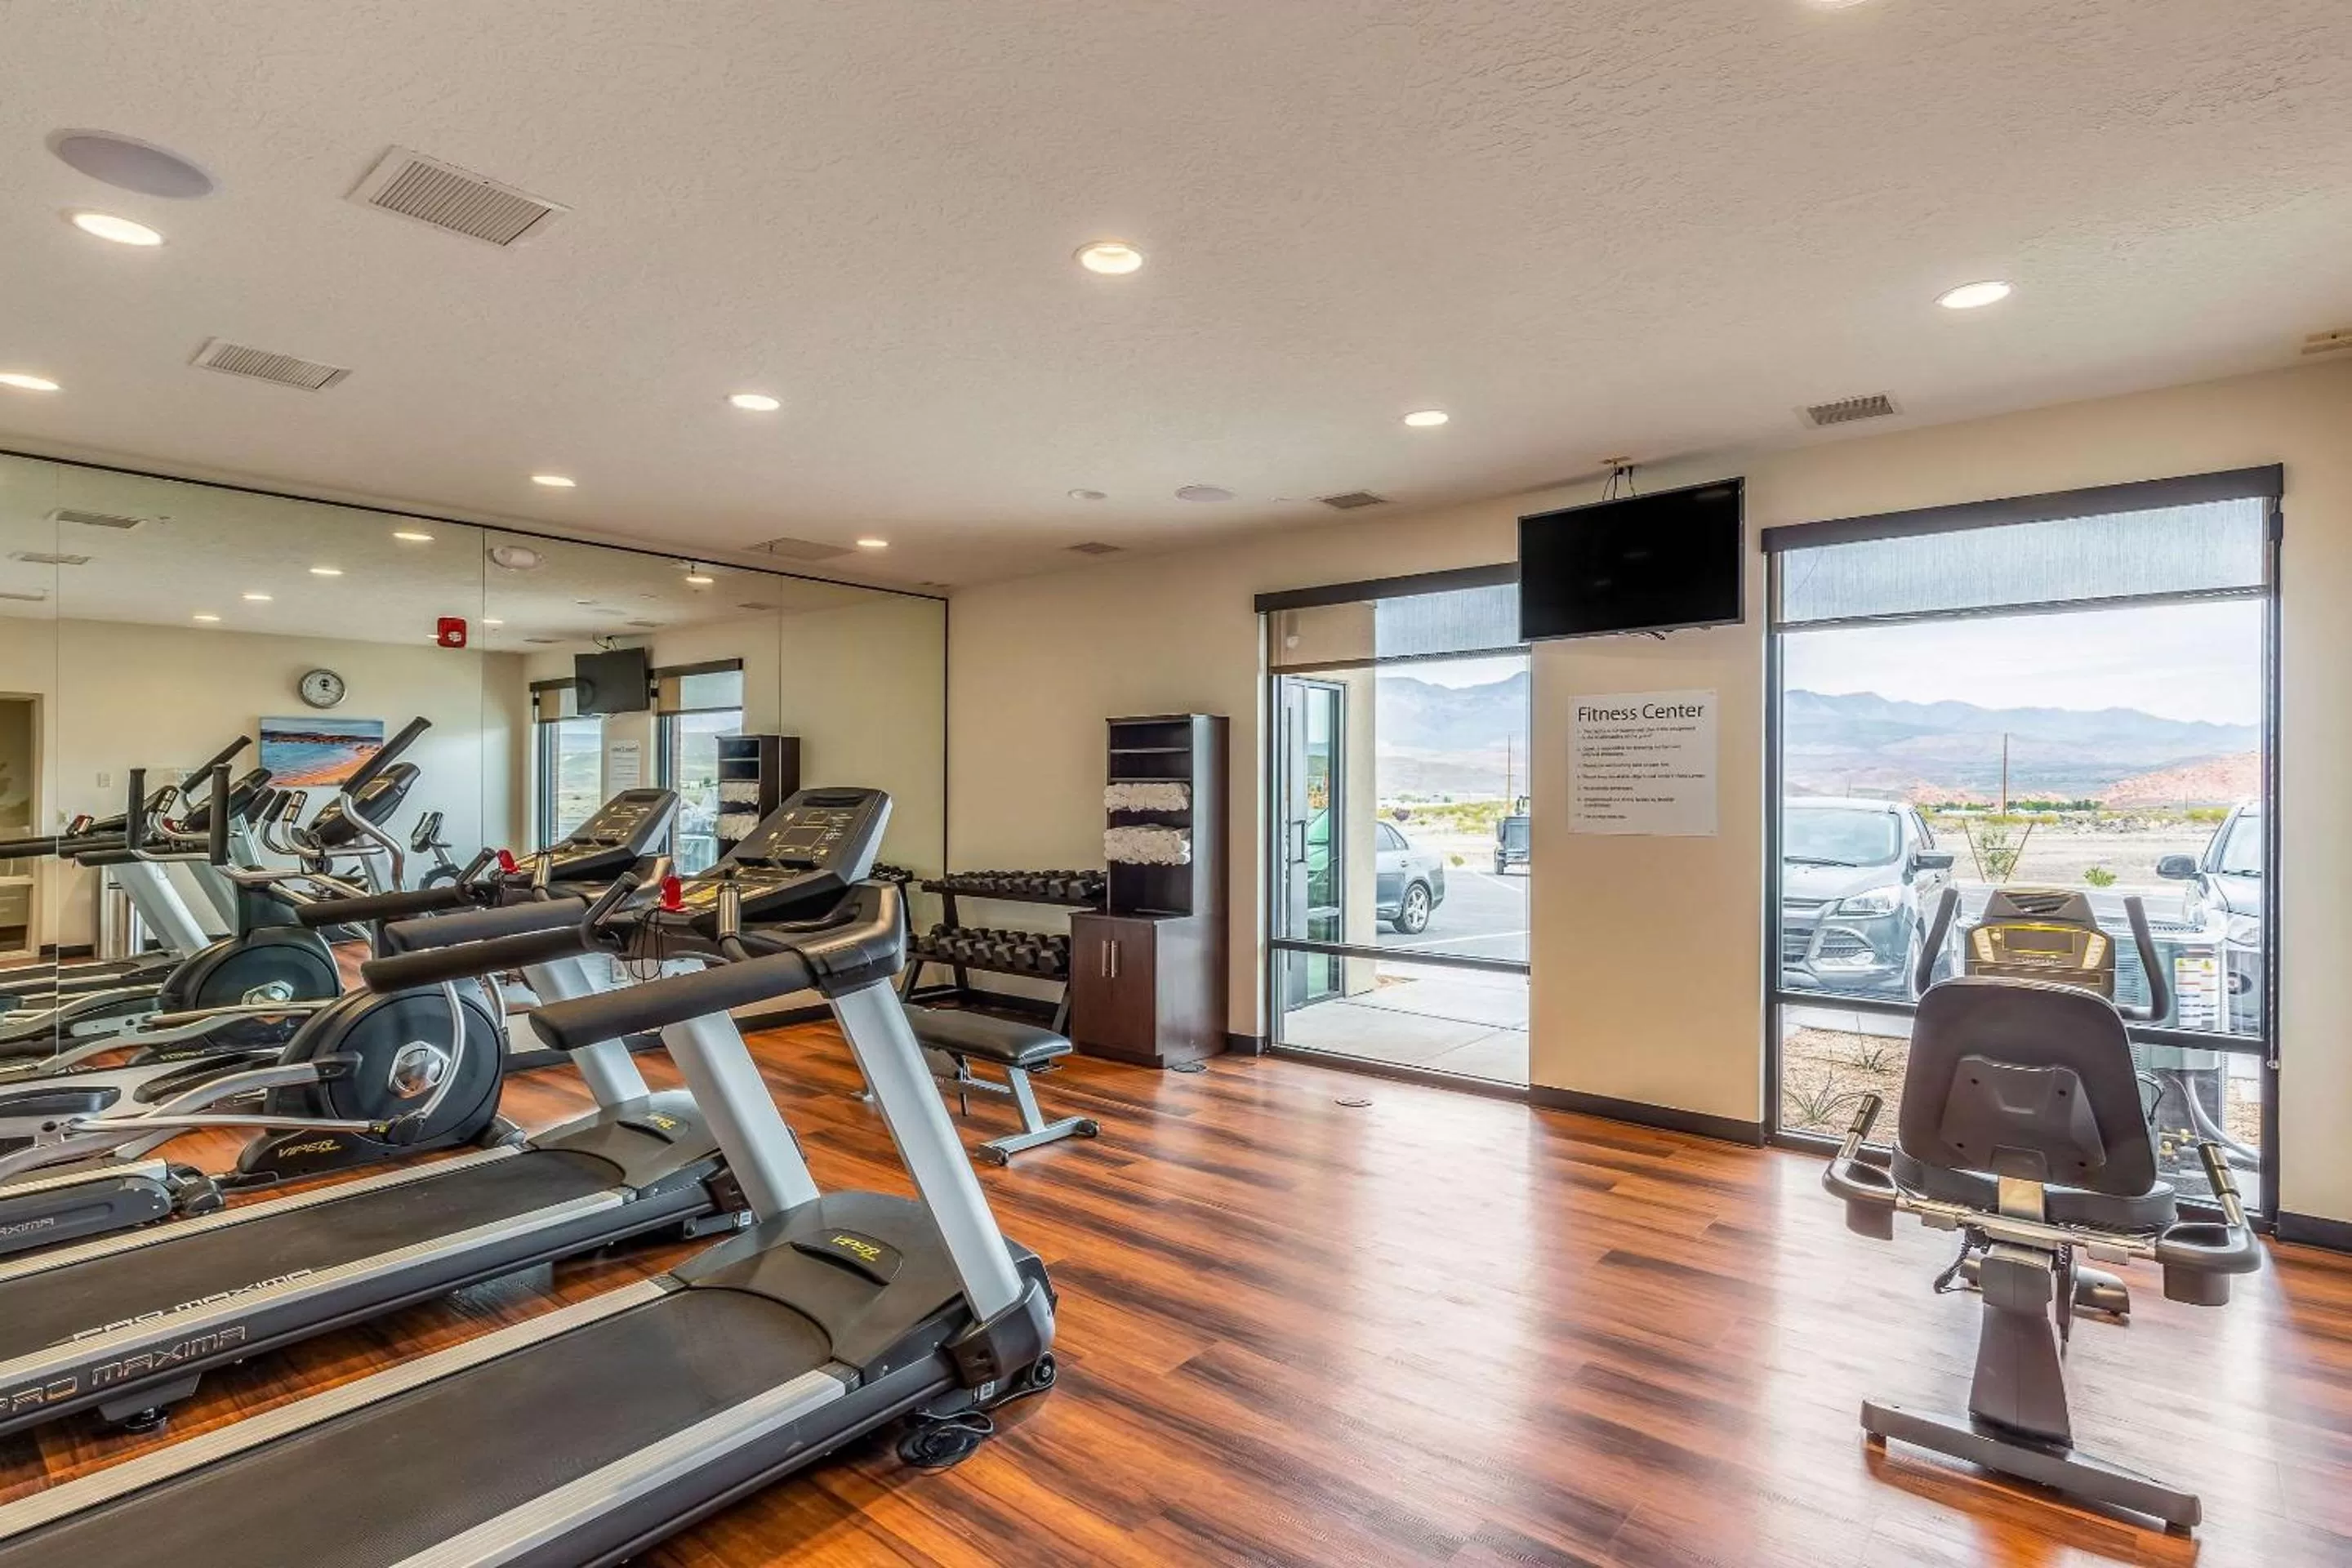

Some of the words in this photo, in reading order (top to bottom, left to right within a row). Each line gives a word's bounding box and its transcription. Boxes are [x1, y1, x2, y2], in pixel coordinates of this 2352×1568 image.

[1578, 706, 1637, 722] Fitness
[1642, 703, 1704, 719] Center
[277, 1138, 337, 1158] VIPER
[0, 1377, 78, 1412] RO
[91, 1325, 246, 1386] MAXIMA
